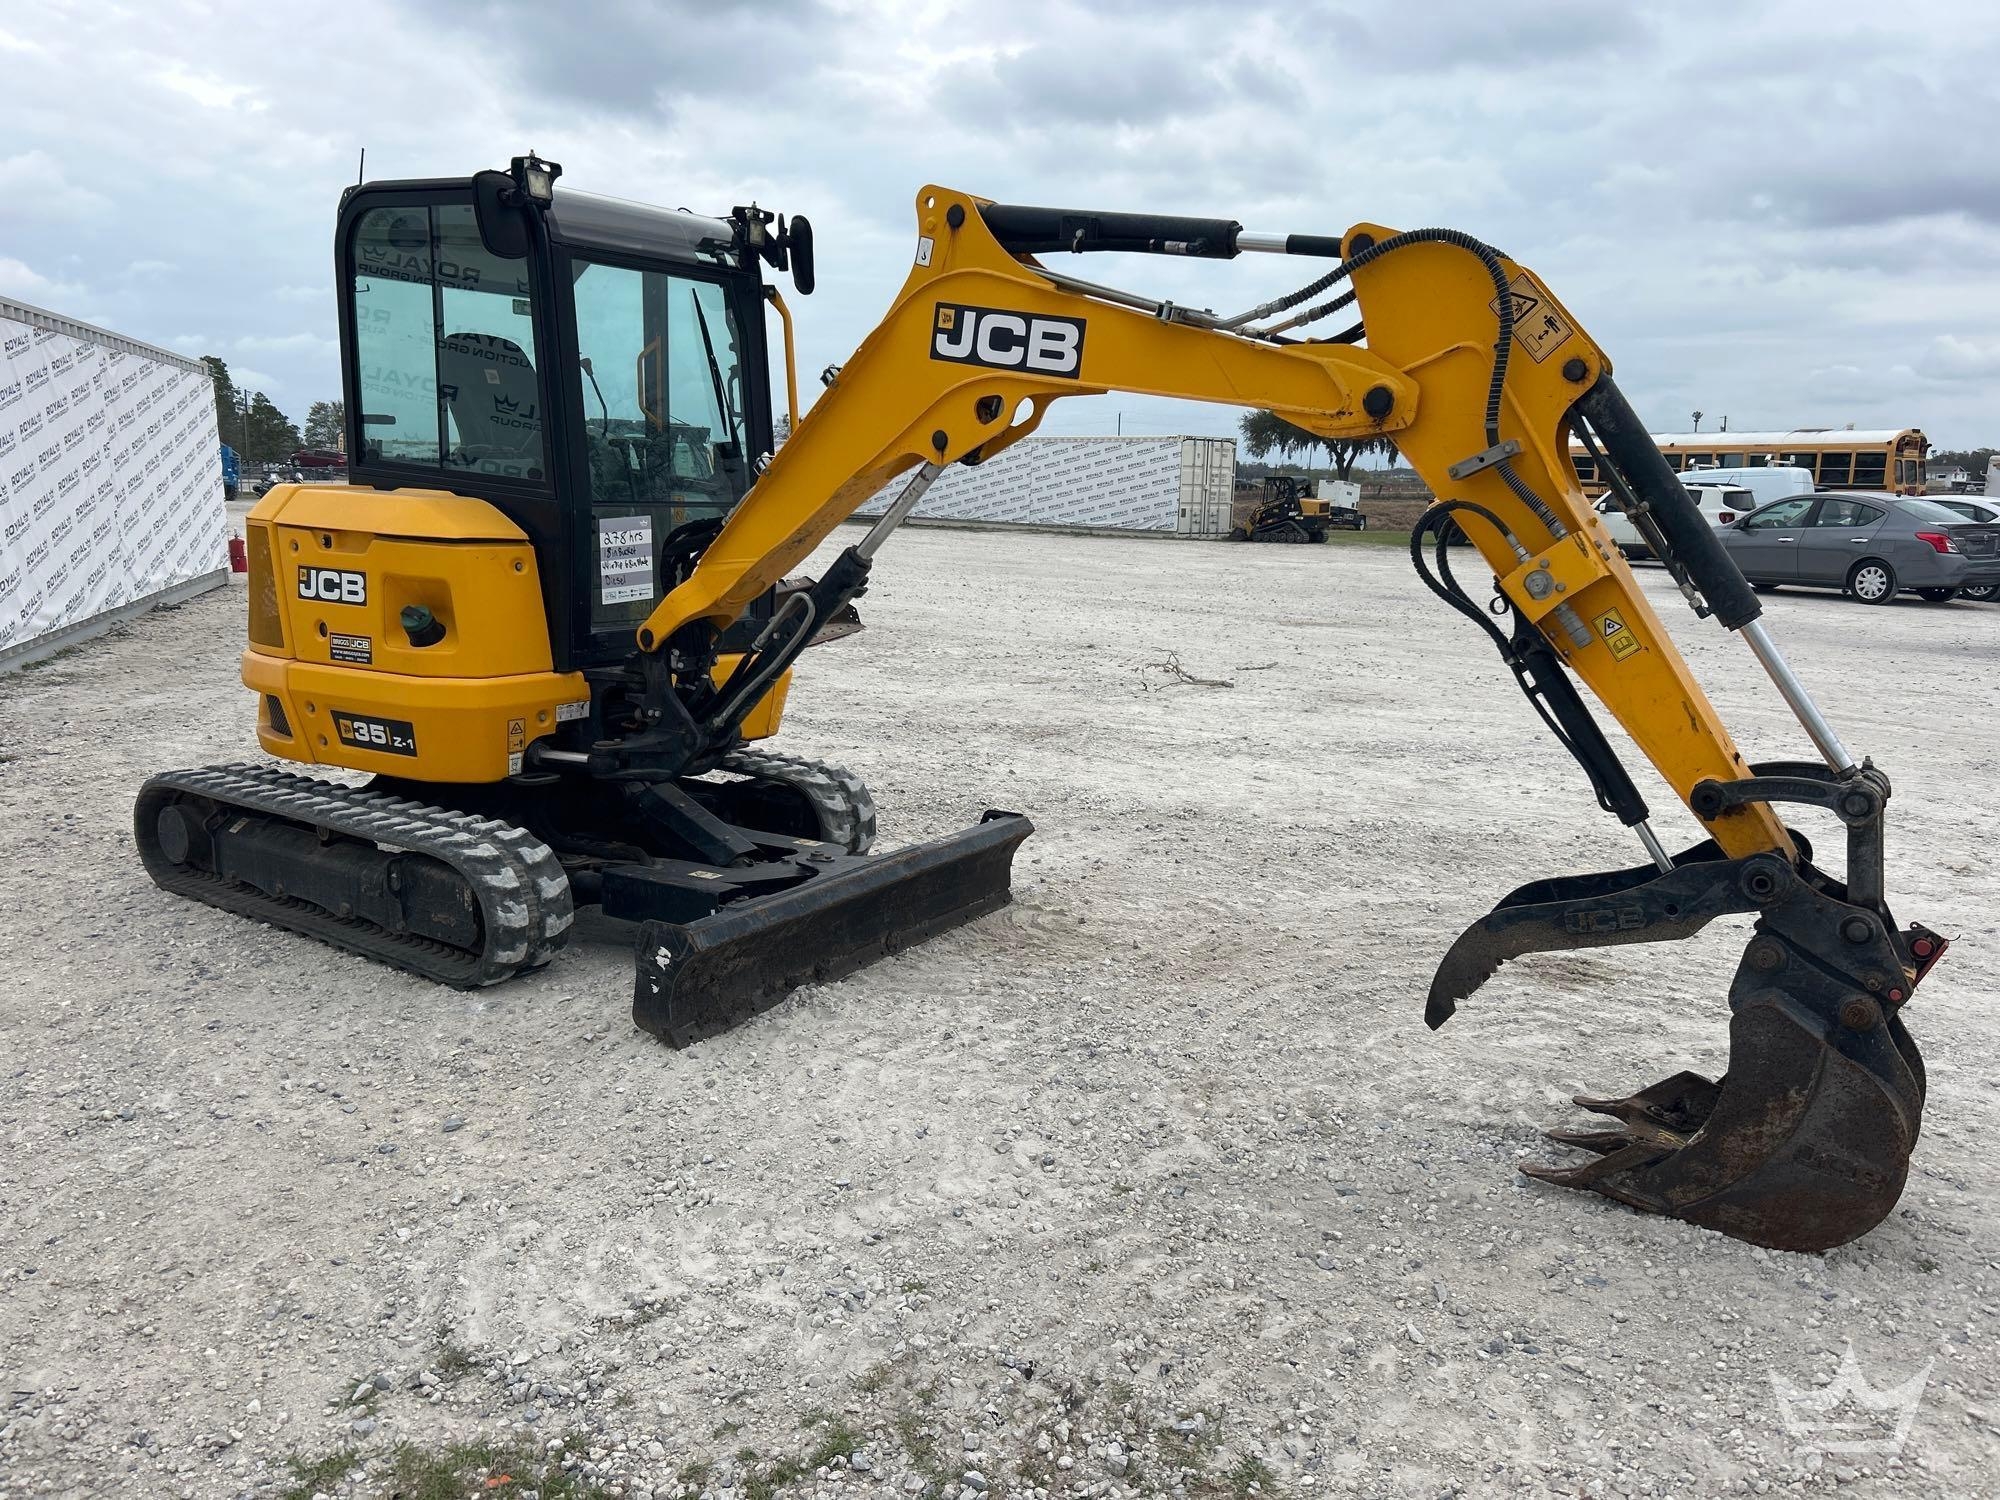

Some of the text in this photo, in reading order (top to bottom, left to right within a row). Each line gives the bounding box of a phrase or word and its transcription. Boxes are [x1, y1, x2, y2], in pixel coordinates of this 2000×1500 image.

[936, 310, 1079, 372] JCB
[0, 383, 17, 401] OYAL
[0, 572, 17, 593] OYAL
[300, 570, 365, 602] JCB
[605, 575, 626, 586] Diesel
[351, 640, 369, 649] JCB
[353, 721, 386, 744] 35
[1564, 908, 1646, 933] JCB
